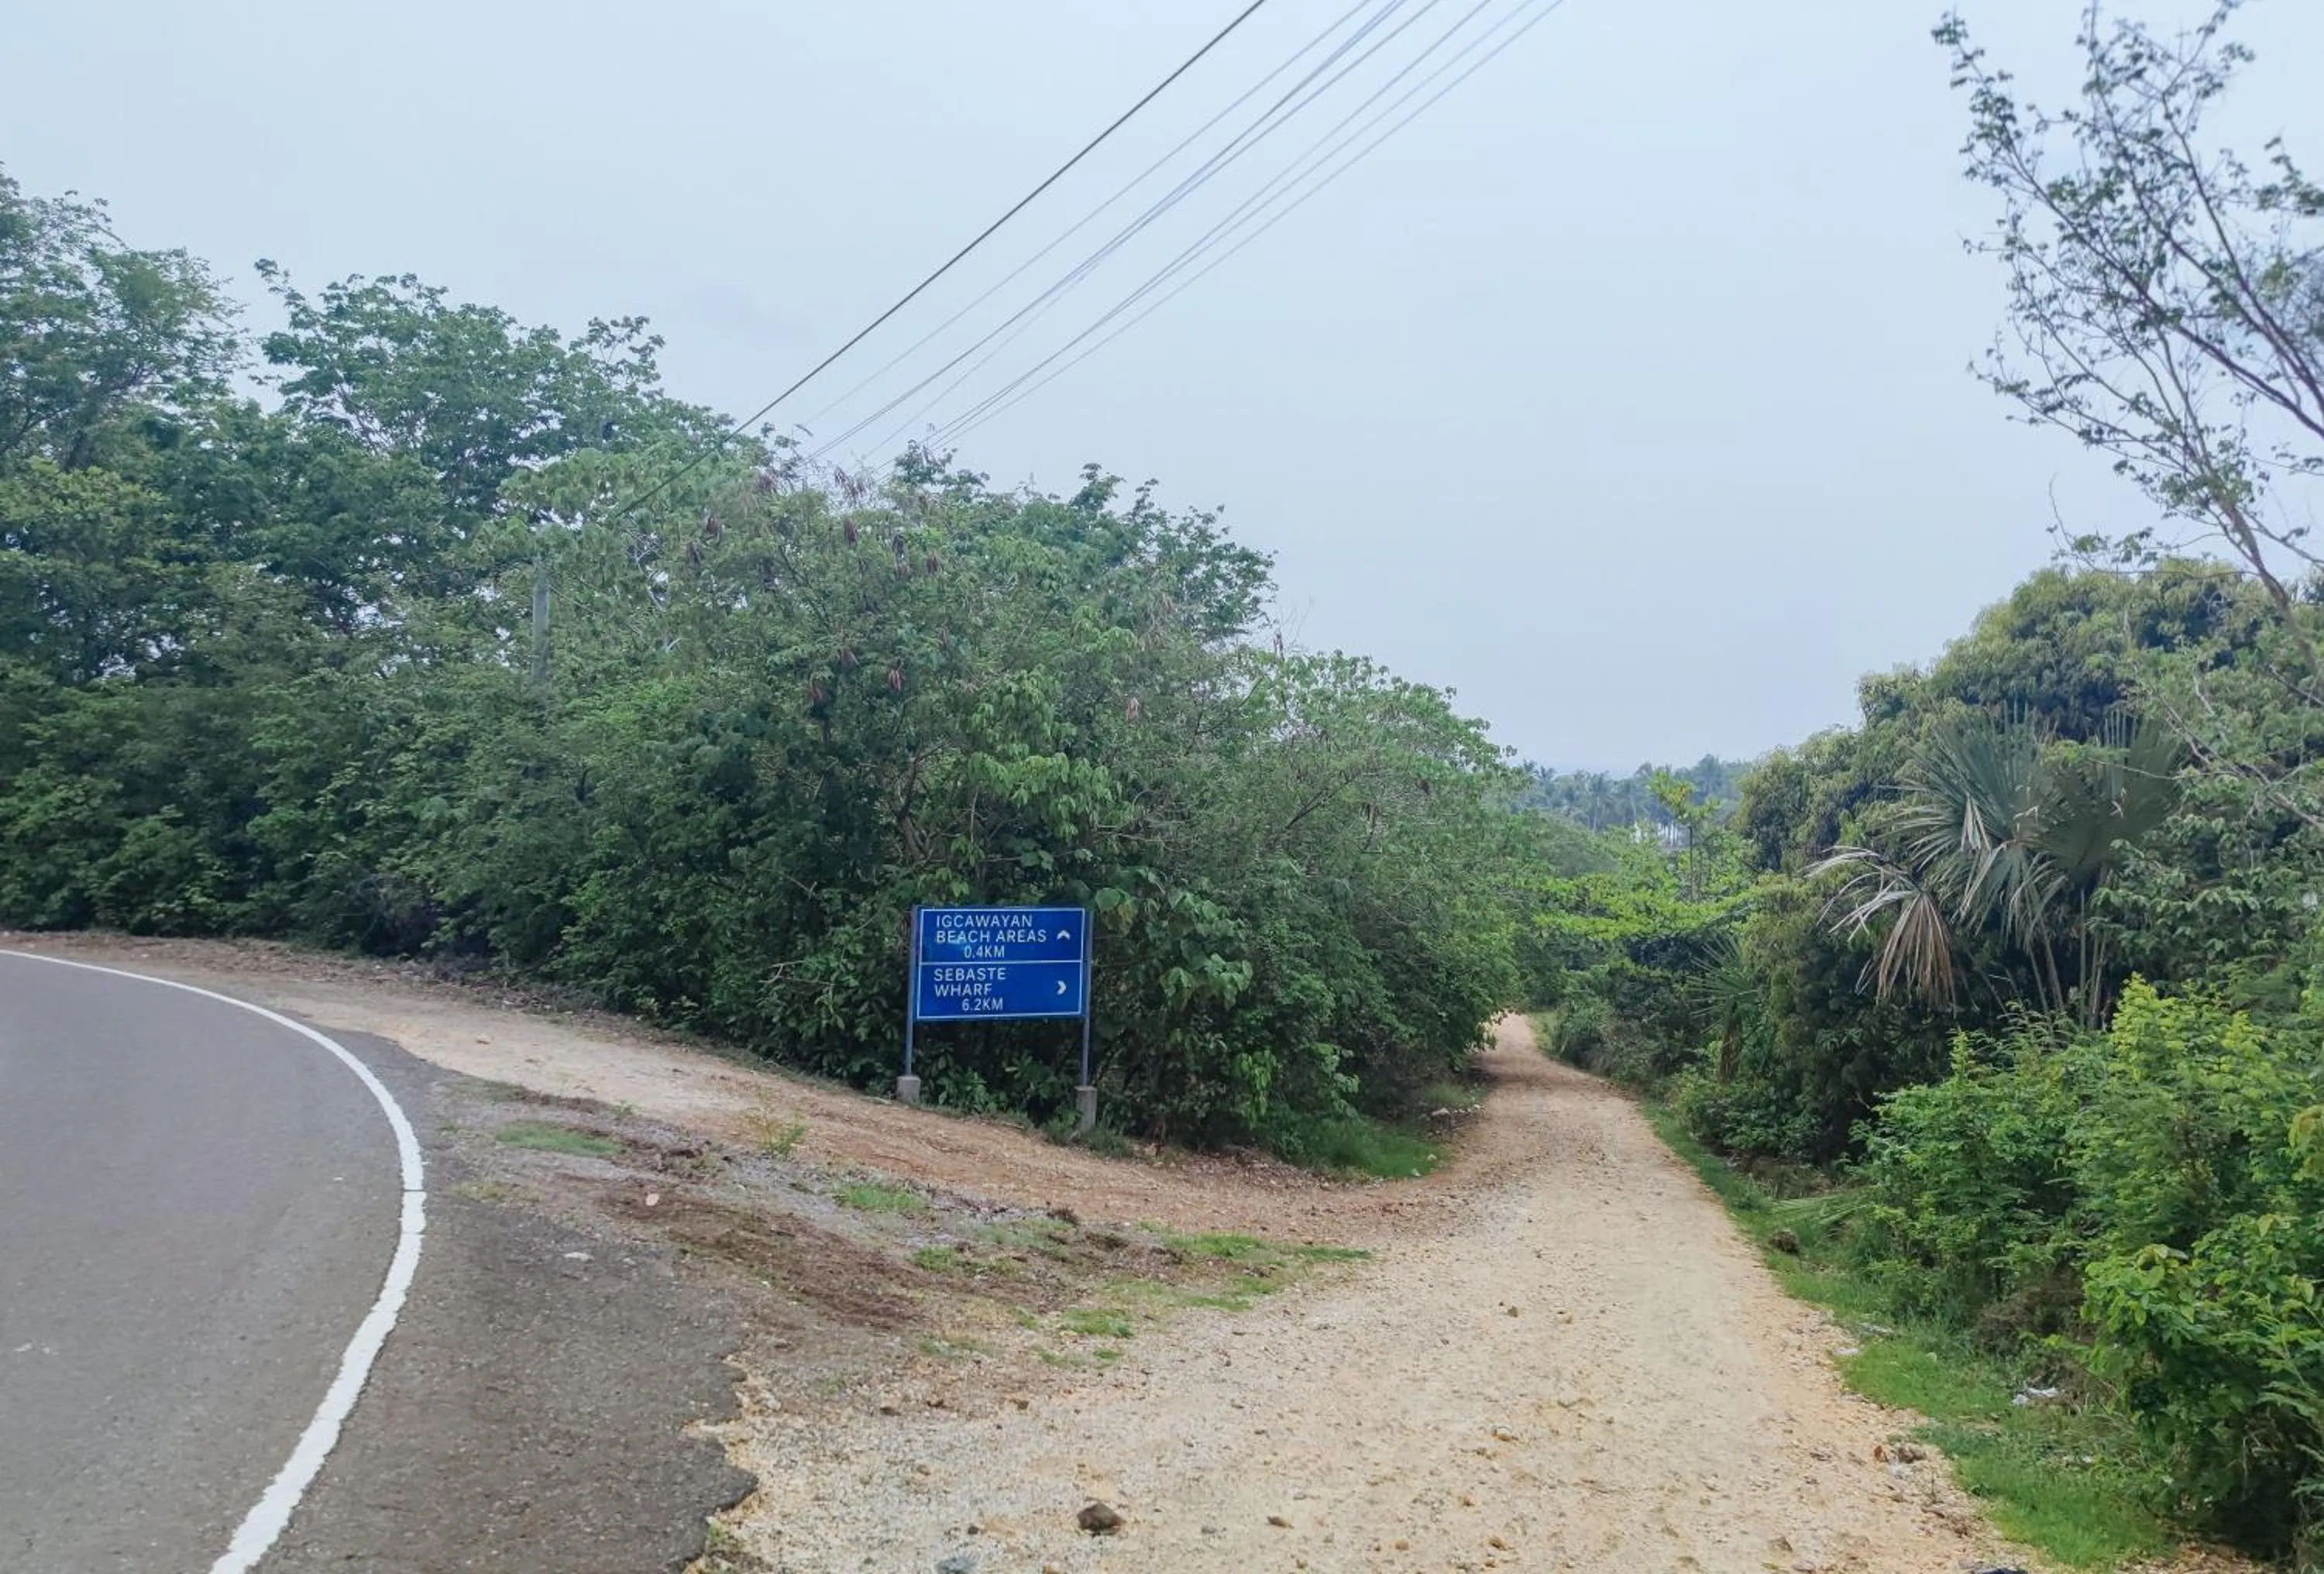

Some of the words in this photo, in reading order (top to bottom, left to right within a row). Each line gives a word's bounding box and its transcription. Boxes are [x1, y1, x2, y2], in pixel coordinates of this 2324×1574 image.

[936, 915, 1033, 928] IGCAWAYAN
[936, 930, 990, 943] BEACH
[995, 930, 1047, 943] AREAS
[964, 945, 1006, 958] 0.4KM
[933, 967, 1007, 981] SEBASTE
[934, 983, 992, 997] WHARF
[961, 998, 1004, 1012] 6.2KM
